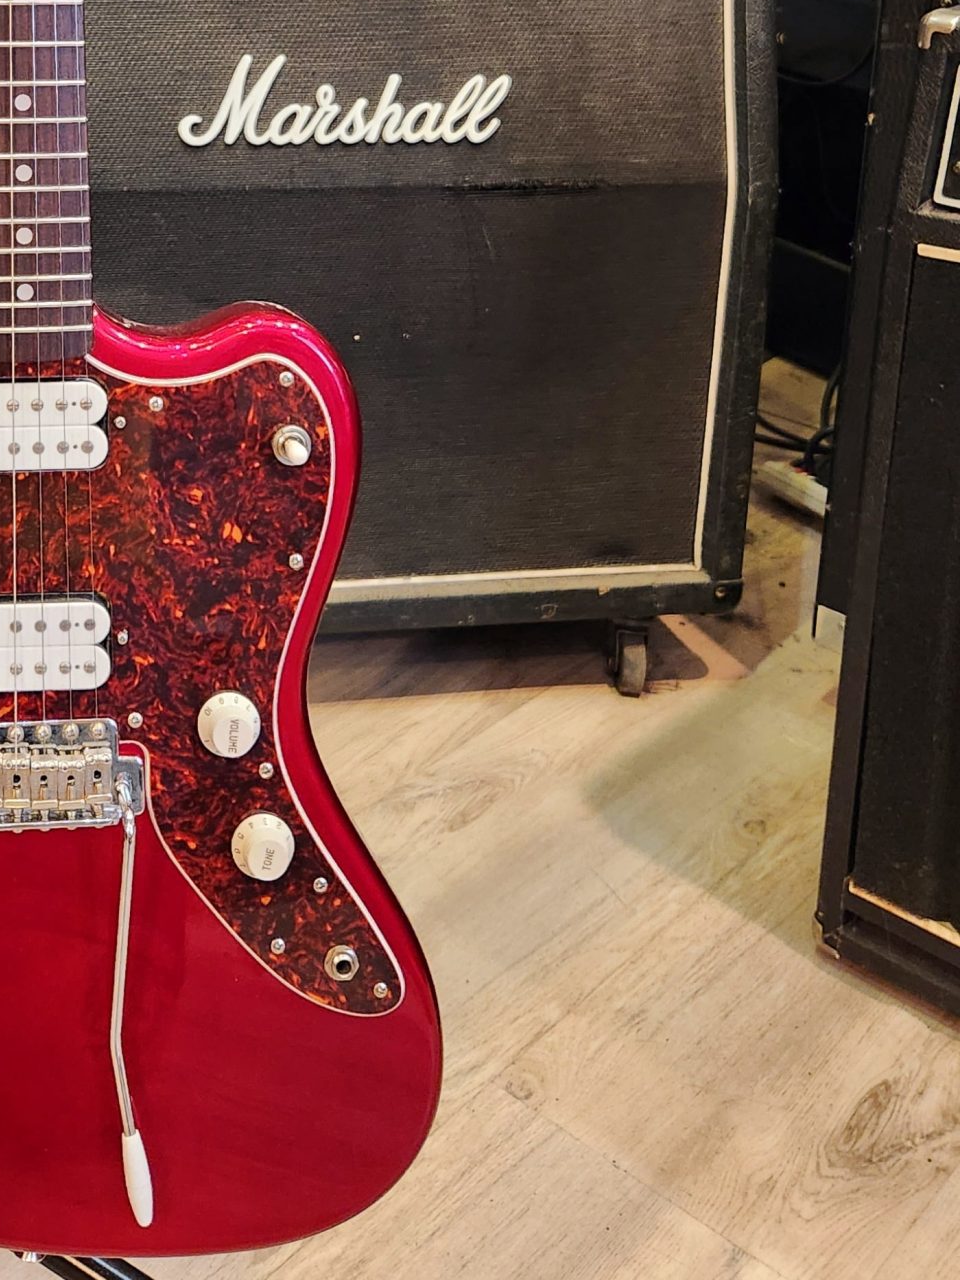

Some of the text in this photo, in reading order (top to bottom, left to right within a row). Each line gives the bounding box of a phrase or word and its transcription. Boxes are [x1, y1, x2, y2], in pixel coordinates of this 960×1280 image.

[177, 53, 513, 147] Marshall
[228, 719, 240, 754] VOLUME
[262, 847, 276, 871] TONE
